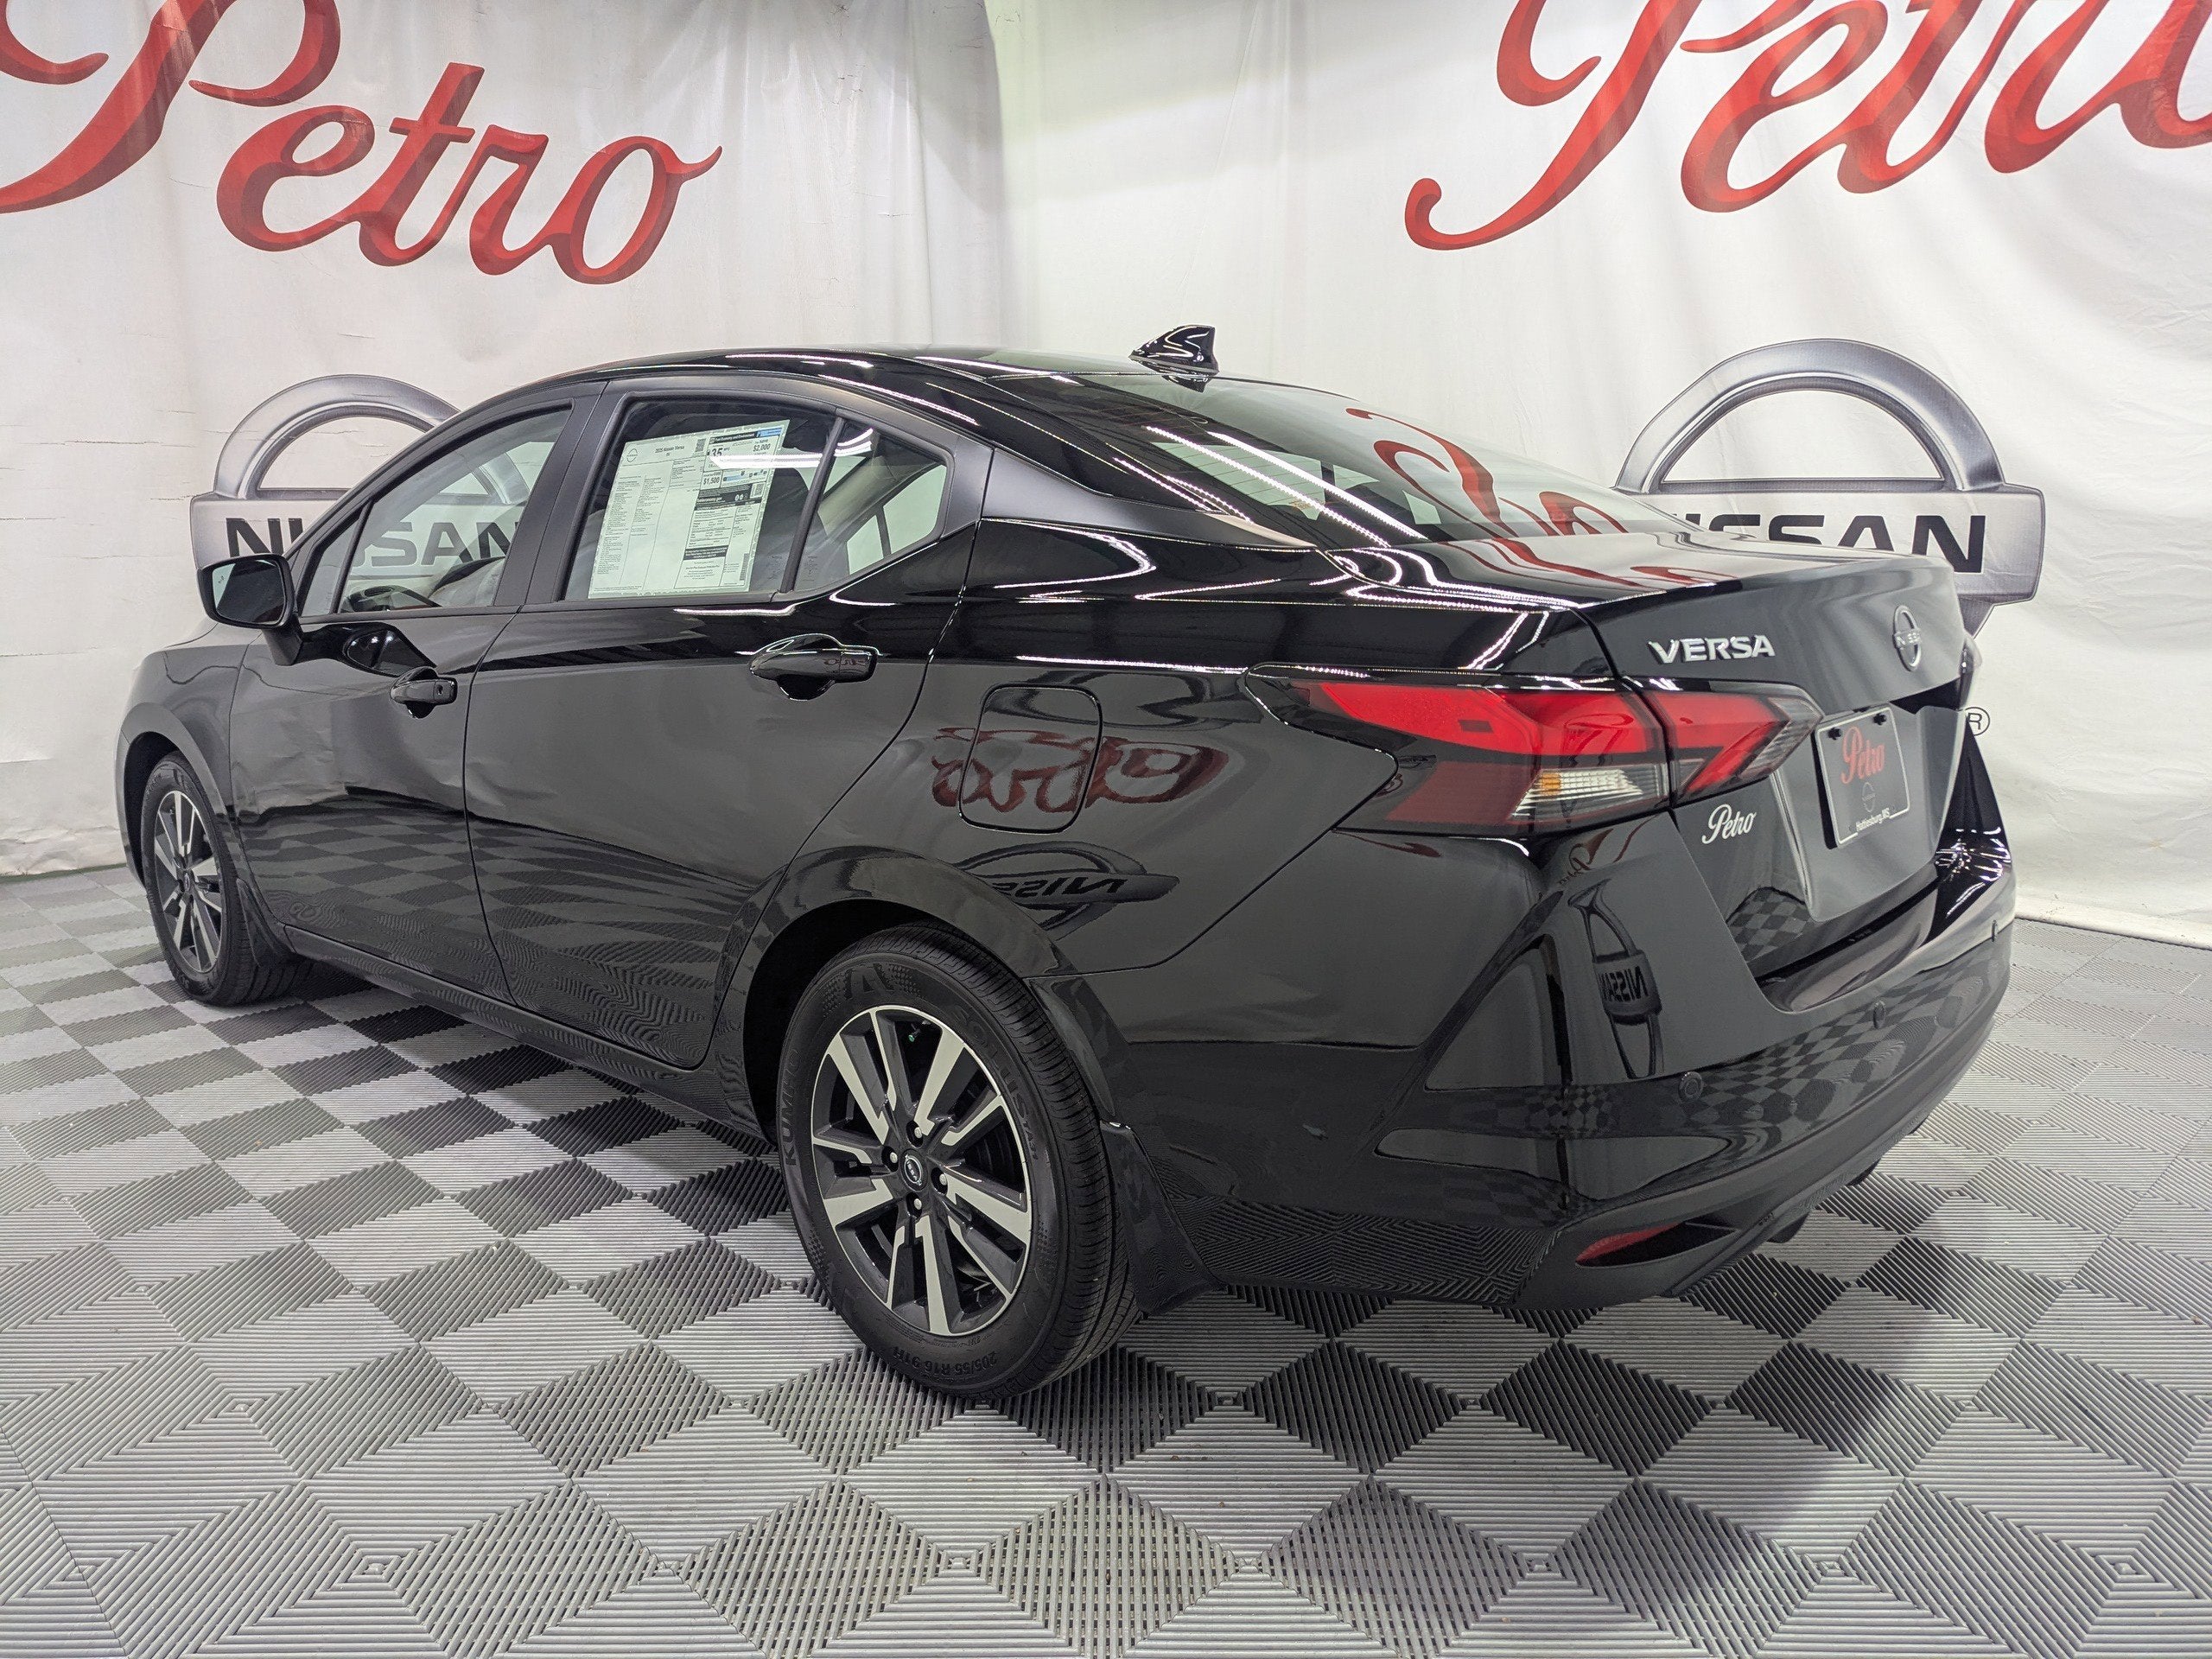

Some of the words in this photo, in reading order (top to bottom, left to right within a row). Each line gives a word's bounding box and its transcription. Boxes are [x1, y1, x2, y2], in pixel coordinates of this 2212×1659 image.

[1648, 634, 1776, 664] VERSA
[1840, 726, 1885, 785] Petro
[1701, 804, 1757, 844] Petro
